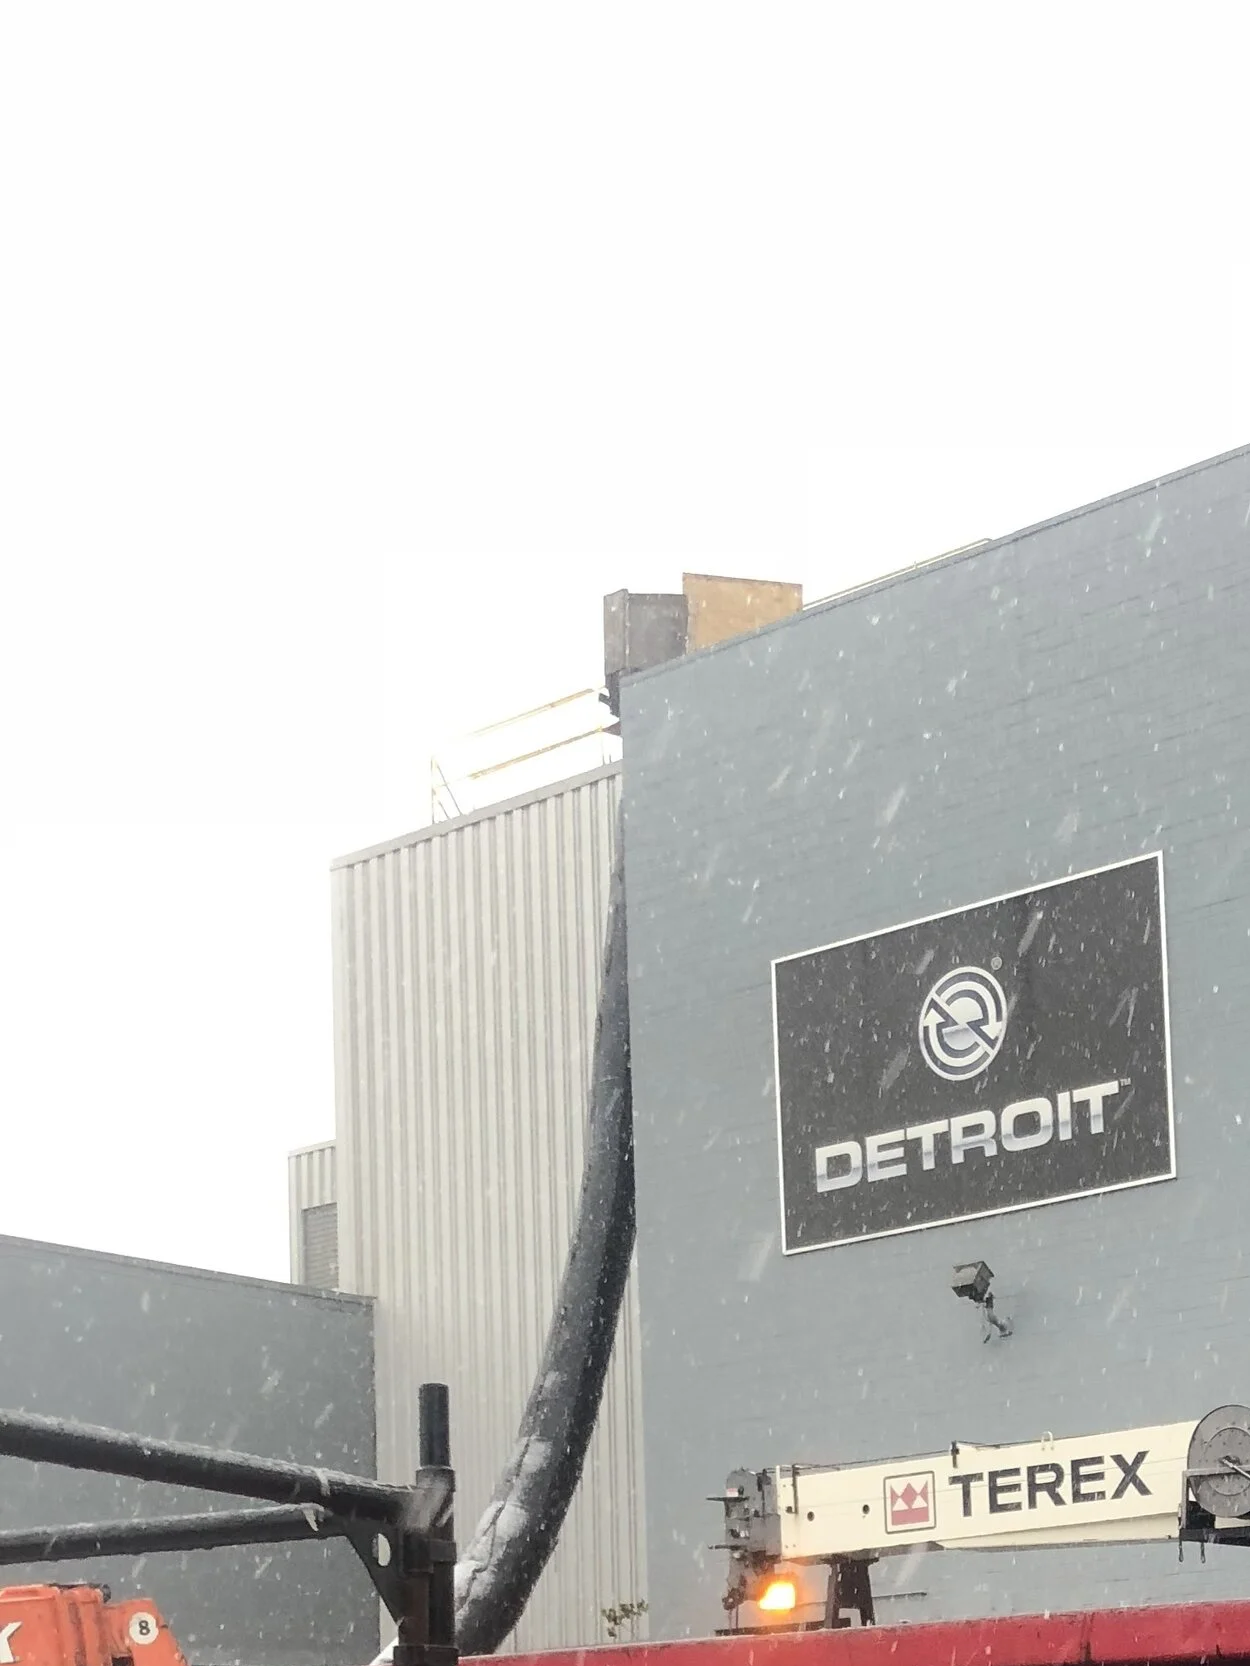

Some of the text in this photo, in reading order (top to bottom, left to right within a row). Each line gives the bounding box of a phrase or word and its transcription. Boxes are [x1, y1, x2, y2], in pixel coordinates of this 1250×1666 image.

[815, 1080, 1119, 1193] DETROIT
[948, 1450, 1152, 1517] TEREX
[138, 1620, 150, 1636] 8
